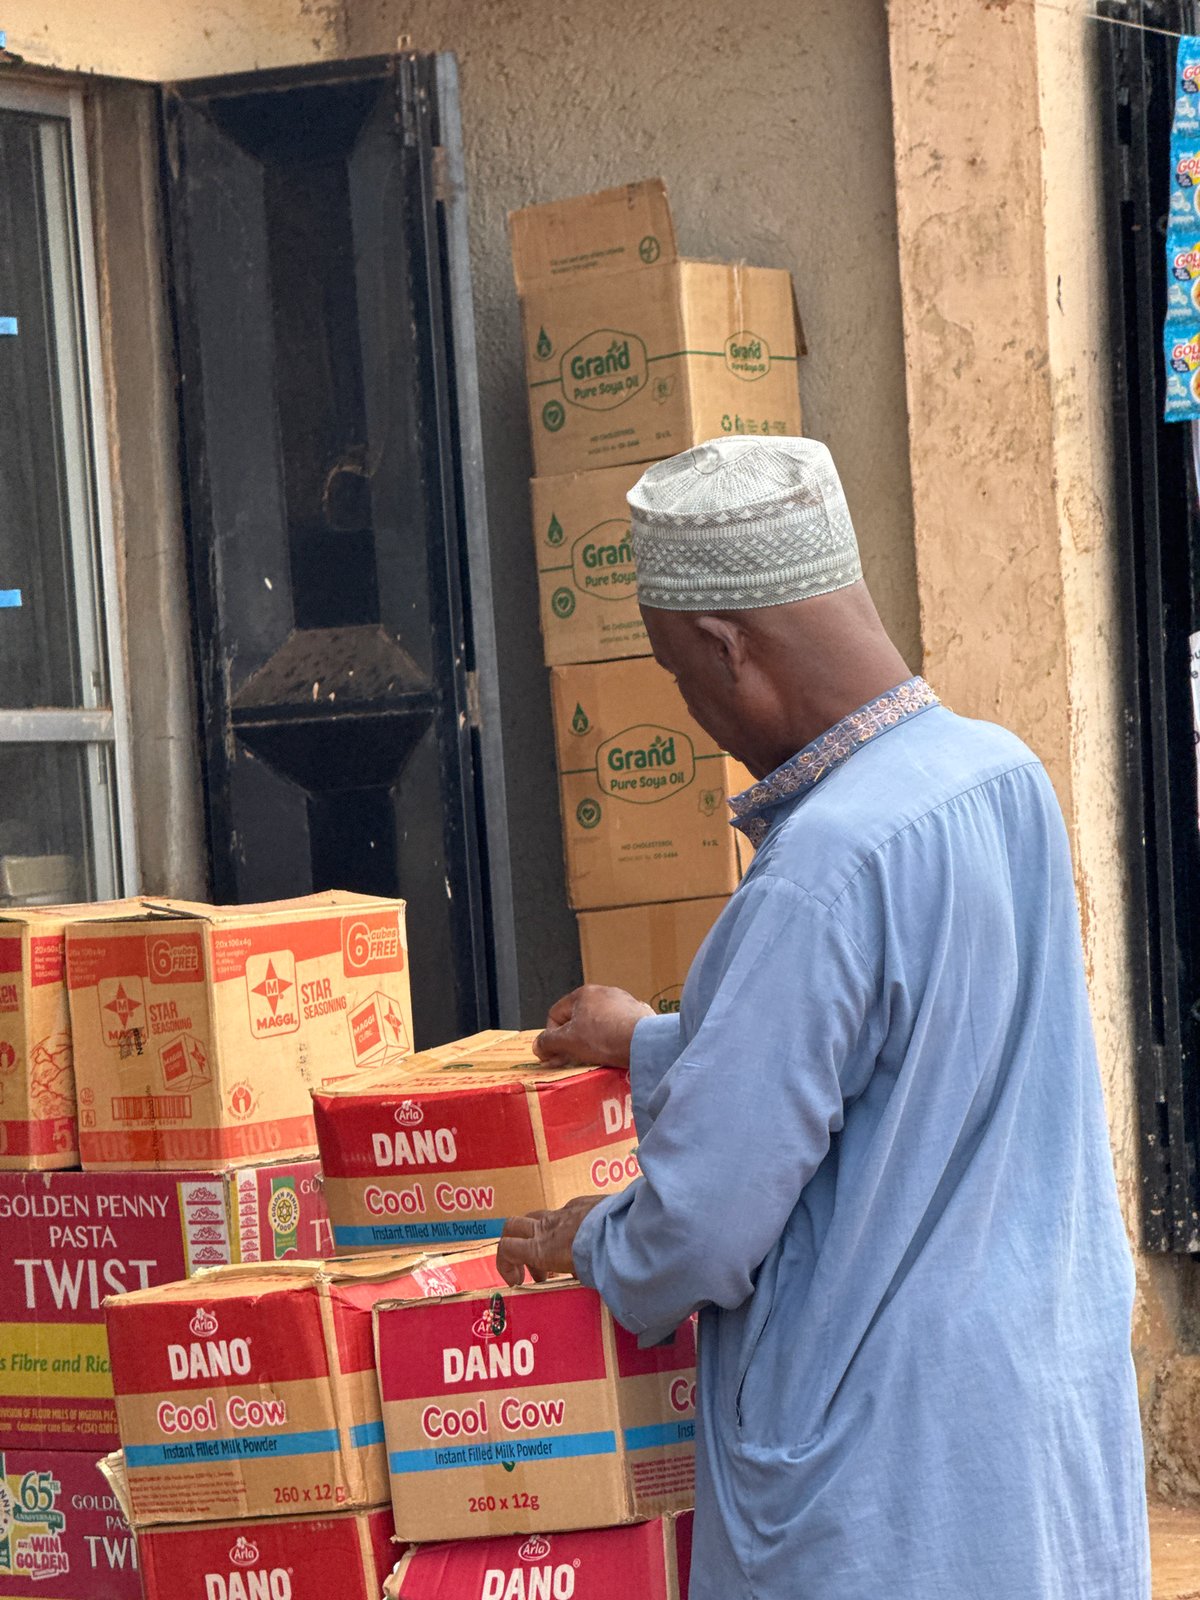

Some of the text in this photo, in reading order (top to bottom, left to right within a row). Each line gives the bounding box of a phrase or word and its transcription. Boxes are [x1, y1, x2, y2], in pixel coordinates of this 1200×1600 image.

[1177, 158, 1200, 175] GOL
[1174, 253, 1200, 269] GOL
[730, 341, 761, 359] Grand
[1172, 344, 1200, 361] GOL
[571, 341, 630, 381] Grand
[574, 375, 639, 401] Pure Soya Oil
[585, 572, 637, 588] Pure Soya
[608, 737, 675, 771] Grand
[611, 772, 685, 791] Pure Soya Oil
[347, 922, 398, 968] 6 cubes
[369, 939, 398, 959] FREE
[152, 940, 198, 977] 6 cubes
[171, 955, 198, 971] FREE
[267, 981, 278, 995] M
[301, 978, 333, 1005] STAR
[117, 998, 129, 1012] M
[149, 1000, 178, 1022] STAR
[303, 996, 347, 1021] SEASONING
[658, 998, 680, 1014] Gra
[151, 1017, 193, 1035] SEASONING
[256, 1015, 294, 1031] MAGGI
[352, 1014, 375, 1034] MAGGI
[399, 1110, 419, 1121] Arla
[602, 1094, 634, 1135] DA
[53, 1118, 73, 1153] 5
[235, 1120, 282, 1153] 106
[372, 1128, 458, 1167] DANO
[590, 1154, 641, 1190] Coo
[0, 1195, 170, 1218] GOLDEN PENNY
[271, 1191, 298, 1218] GOLDEN PENNY
[364, 1181, 495, 1215] Cool Cow
[49, 1225, 118, 1248] PASTA
[372, 1222, 487, 1241] Instant Filled Milk Powder
[14, 1259, 157, 1309] TWIST
[193, 1319, 213, 1333] Arla
[11, 1354, 48, 1374] Fibre
[51, 1355, 80, 1373] and
[86, 1355, 112, 1374] Ric
[167, 1338, 251, 1381] DANO
[443, 1338, 536, 1384] DANO
[158, 1396, 286, 1435] Cool Cow
[421, 1396, 565, 1441] Cool Cow
[677, 1423, 696, 1439] Inst
[163, 1438, 278, 1461] Instant Filled Milk Powder
[434, 1441, 553, 1466] Instant Filled Milk Powder
[72, 1495, 123, 1511] GOLDE
[273, 1486, 299, 1504] 260
[303, 1489, 312, 1501] x
[468, 1493, 540, 1513] 260 x 12g
[106, 1515, 130, 1531] PAS
[31, 1536, 60, 1553] WIN
[83, 1536, 138, 1569] TWI
[234, 1548, 254, 1560] Arla
[522, 1543, 545, 1556] Arla
[16, 1553, 68, 1571] GOLDEN
[205, 1568, 292, 1600] DANO
[481, 1564, 576, 1600] DANO
